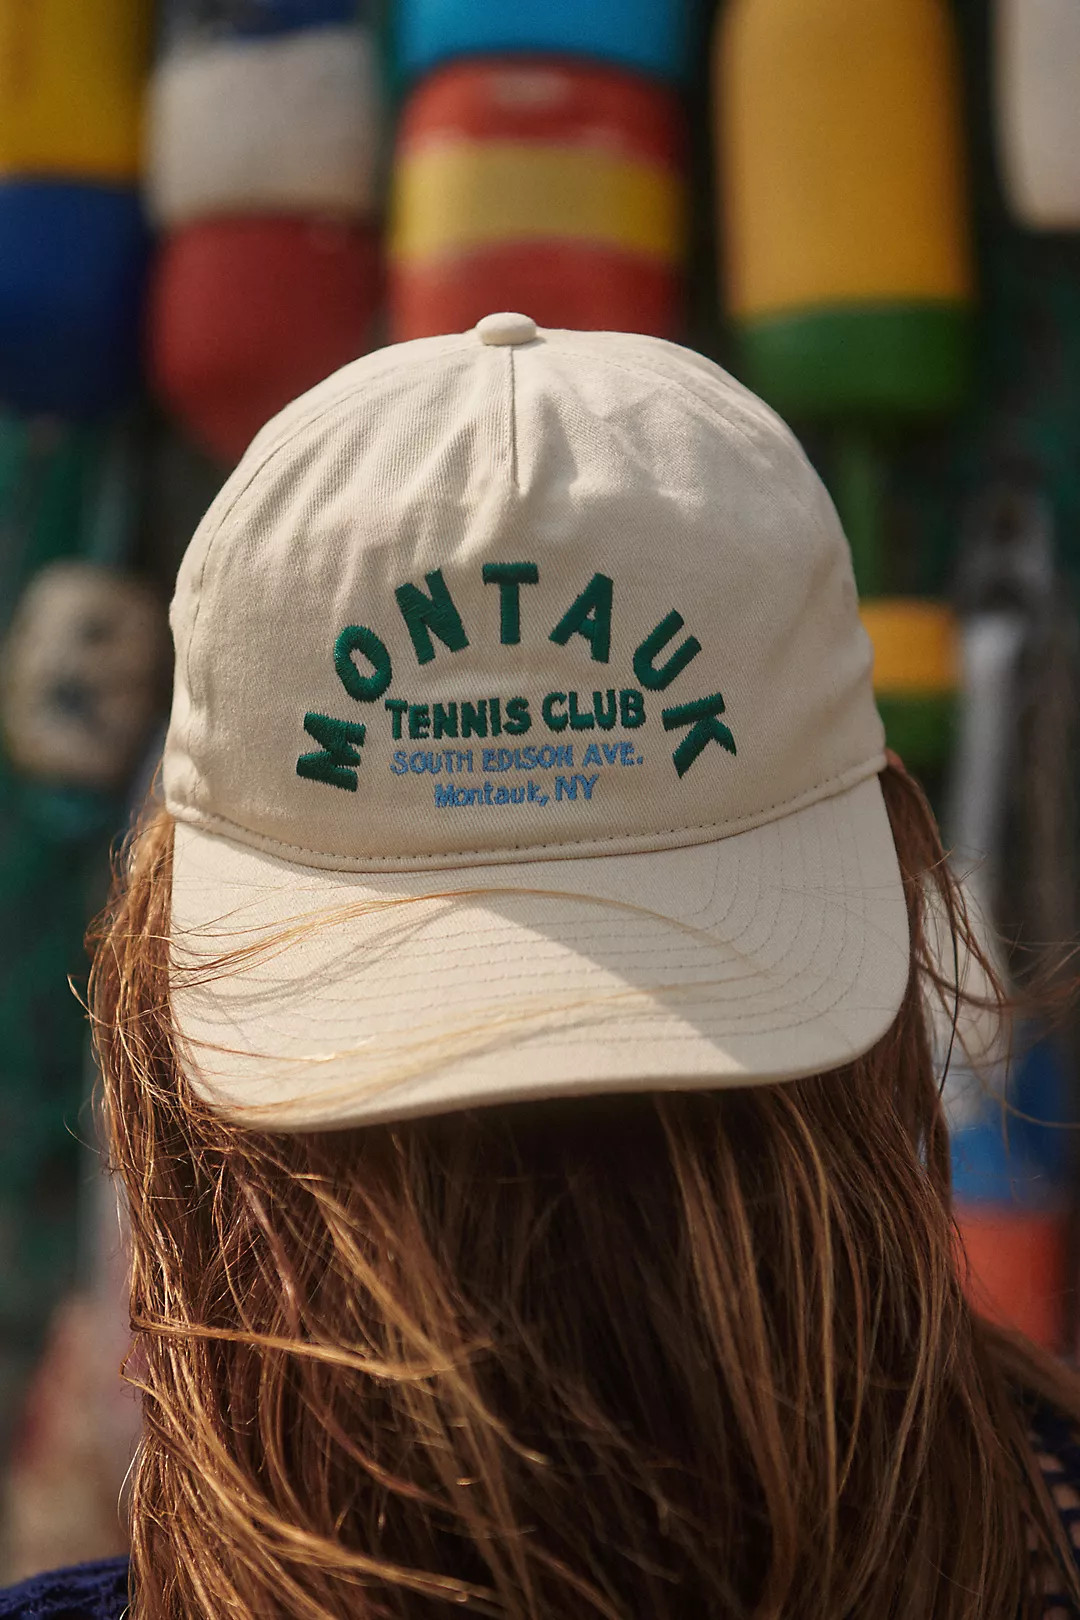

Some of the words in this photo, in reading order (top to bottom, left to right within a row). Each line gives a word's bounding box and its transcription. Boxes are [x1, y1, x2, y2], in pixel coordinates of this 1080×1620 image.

[296, 562, 737, 793] MONTAUK
[384, 697, 533, 740] TENNIS
[541, 689, 646, 731] CLUB
[389, 750, 473, 775] SOUTH
[482, 744, 573, 773] EDISON
[583, 741, 644, 767] AVE.
[434, 780, 550, 808] Montauk,
[555, 774, 600, 802] NY
